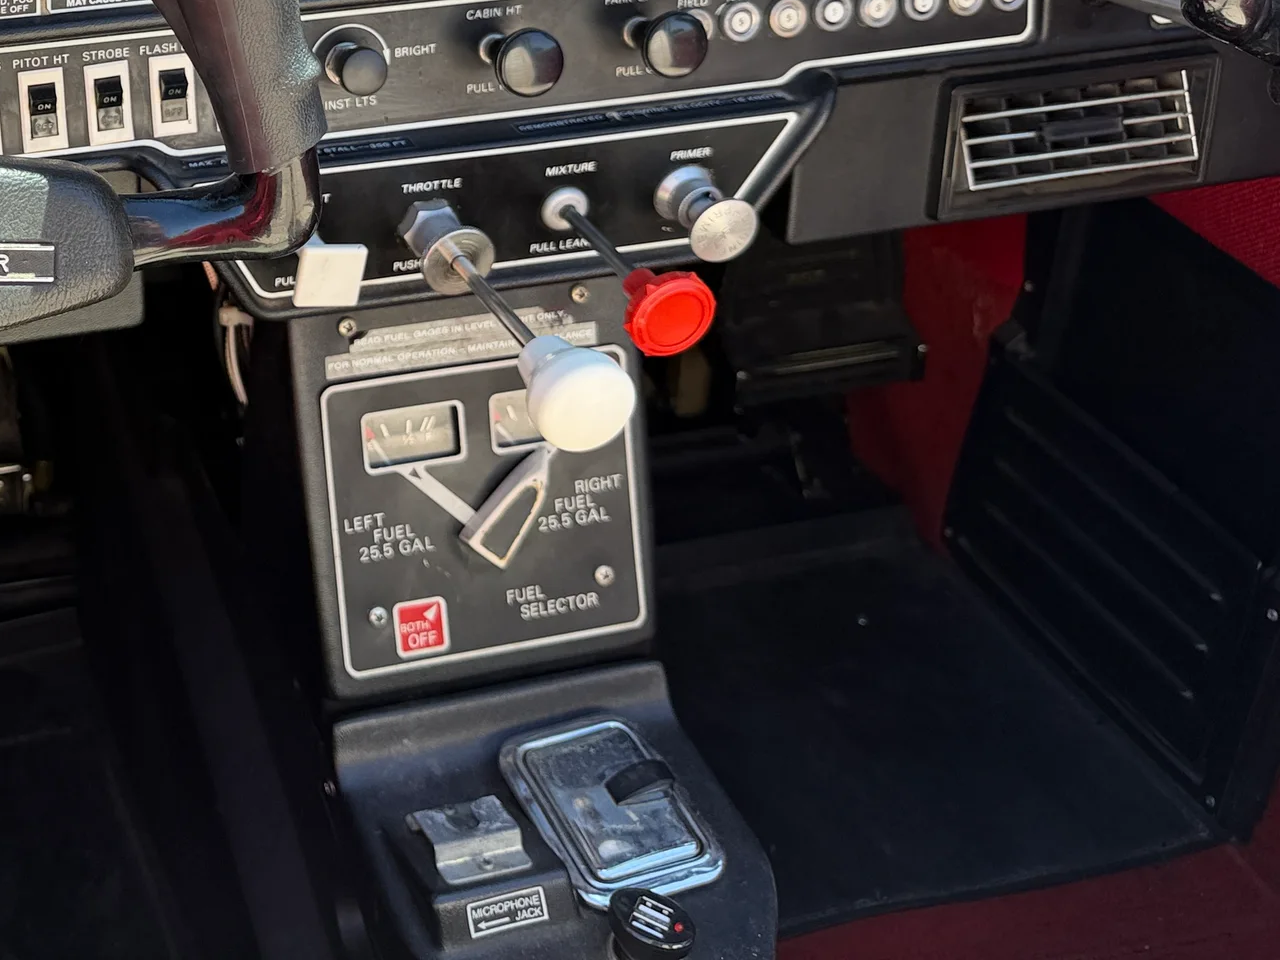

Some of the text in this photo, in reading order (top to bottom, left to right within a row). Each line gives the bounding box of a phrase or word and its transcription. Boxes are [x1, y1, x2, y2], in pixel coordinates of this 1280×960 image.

[9, 3, 30, 14] OFF
[466, 5, 522, 21] CABIN HT
[82, 47, 130, 62] STROBE
[139, 42, 178, 56] FLASH
[394, 43, 437, 58] BRIGHT
[13, 54, 70, 69] PITOT HT
[324, 95, 377, 111] INST LTS
[670, 147, 712, 160] PRIMER
[545, 161, 597, 177] MIXTURE
[401, 177, 463, 194] THROTTLE
[529, 241, 555, 253] PULL
[575, 474, 621, 493] RIGHT
[555, 495, 596, 512] FUEL
[344, 512, 385, 533] LEFT
[537, 507, 610, 532] 25.5 GAL
[374, 524, 416, 542] FUEL
[359, 537, 435, 562] 25.5 GAL
[506, 585, 546, 604] FUEL
[520, 592, 600, 619] SELECTOR
[400, 620, 431, 634] BOTH
[408, 630, 438, 648] OFF
[472, 894, 541, 920] MICROPHONE
[515, 906, 544, 921] JACK
